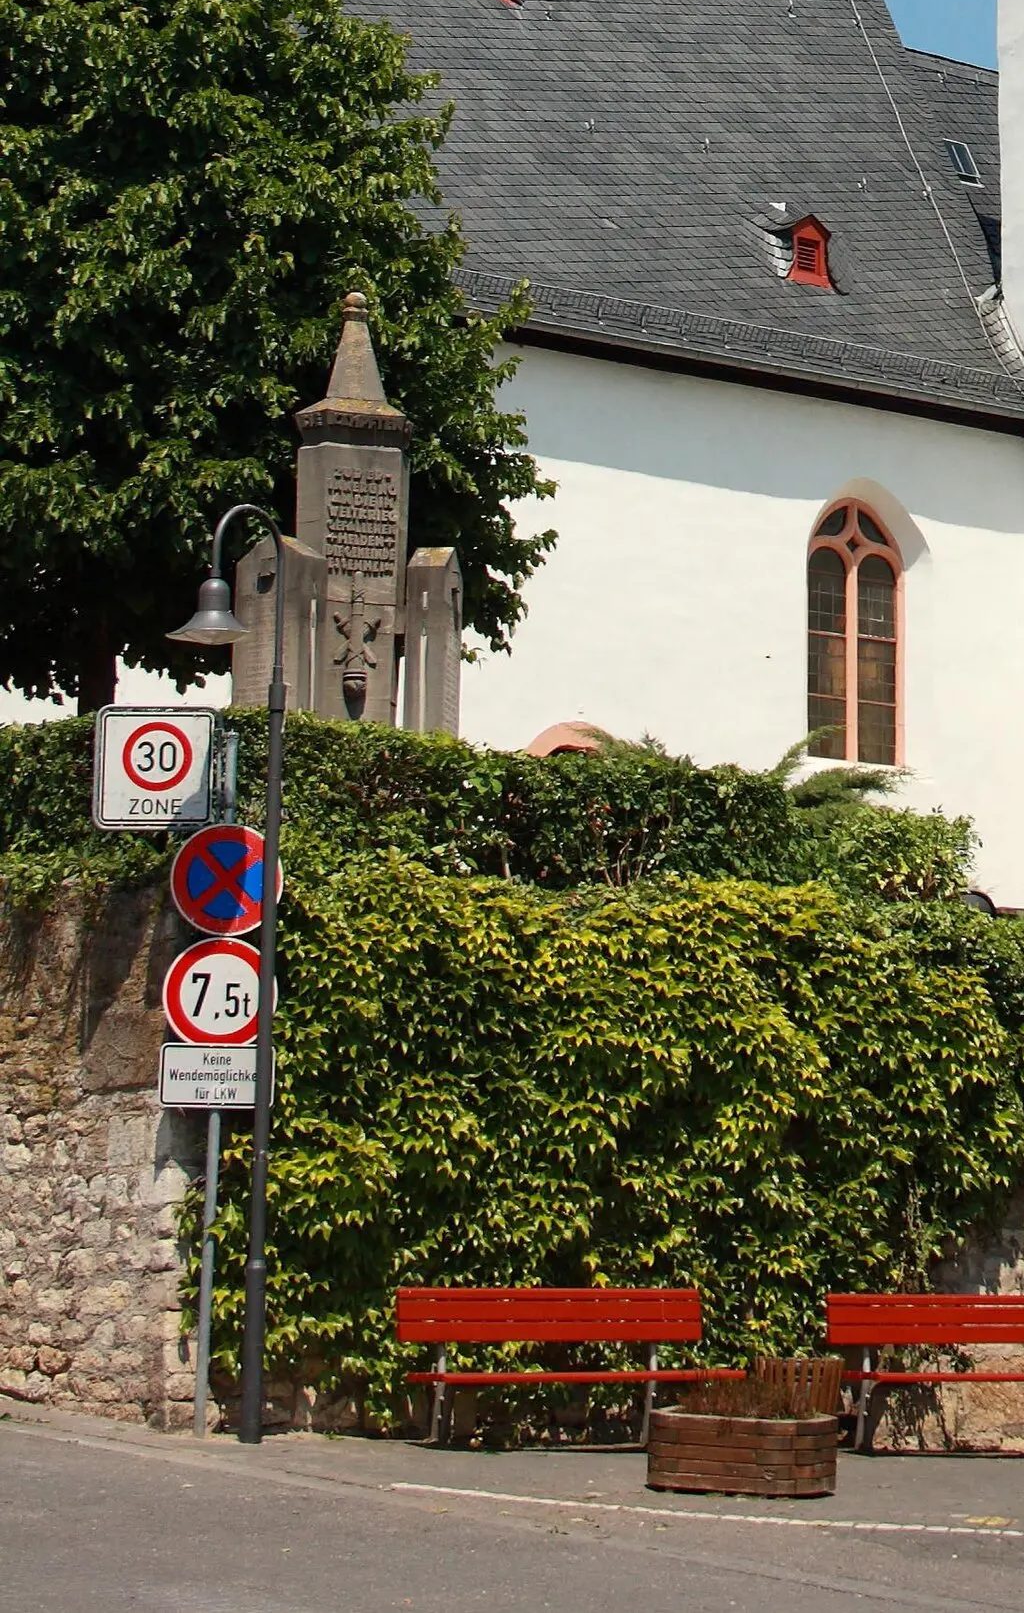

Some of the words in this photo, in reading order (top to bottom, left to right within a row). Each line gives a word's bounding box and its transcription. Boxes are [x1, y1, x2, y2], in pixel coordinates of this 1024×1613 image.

[327, 503, 399, 524] WELTKRIEG
[137, 741, 177, 773] 30
[128, 798, 183, 815] ZONE
[203, 1052, 232, 1066] Keine
[168, 1067, 257, 1085] Wendemöglichke
[194, 1086, 210, 1100] für
[213, 1086, 238, 1100] LKW
